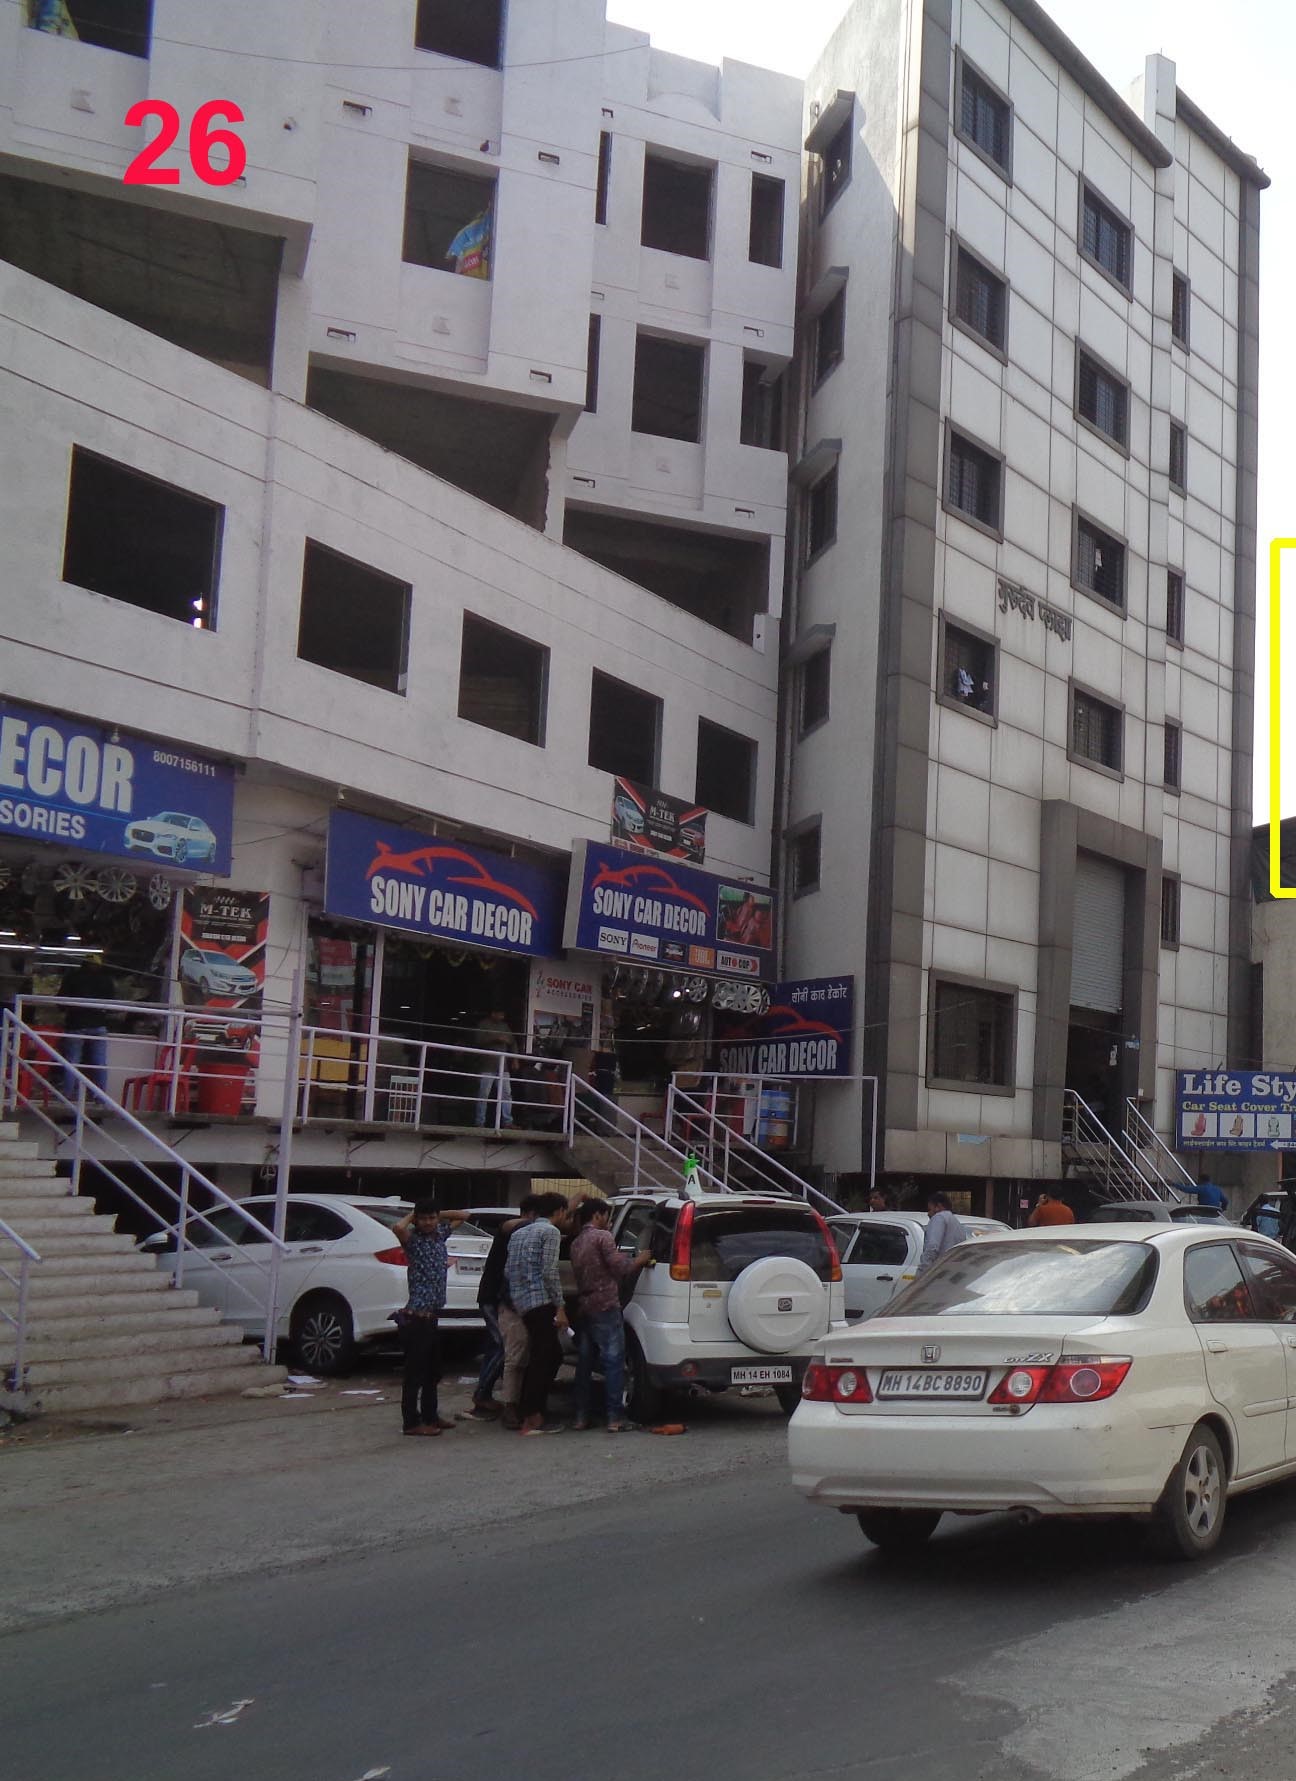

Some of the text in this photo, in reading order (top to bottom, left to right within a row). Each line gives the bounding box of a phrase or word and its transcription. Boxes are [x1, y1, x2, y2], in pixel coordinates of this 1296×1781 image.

[0, 716, 134, 813] ECOR
[153, 750, 217, 777] 8007156111
[0, 799, 85, 841] SORIES
[200, 903, 252, 919] M-TEK
[371, 875, 532, 945] SONY CAR DECOR
[592, 886, 706, 936] SONY CAR DECOR
[599, 931, 628, 946] SONY
[631, 938, 657, 952] Pioneer
[546, 976, 573, 991] SONY
[720, 1039, 838, 1074] SONY CAR DECOR
[1182, 1073, 1242, 1096] Life
[1182, 1101, 1206, 1111] Car
[1208, 1101, 1238, 1112] Seat
[1240, 1102, 1278, 1112] Cover
[687, 1174, 696, 1185] A
[733, 1370, 746, 1380] MH
[749, 1370, 758, 1379] 14
[759, 1370, 770, 1379] EH
